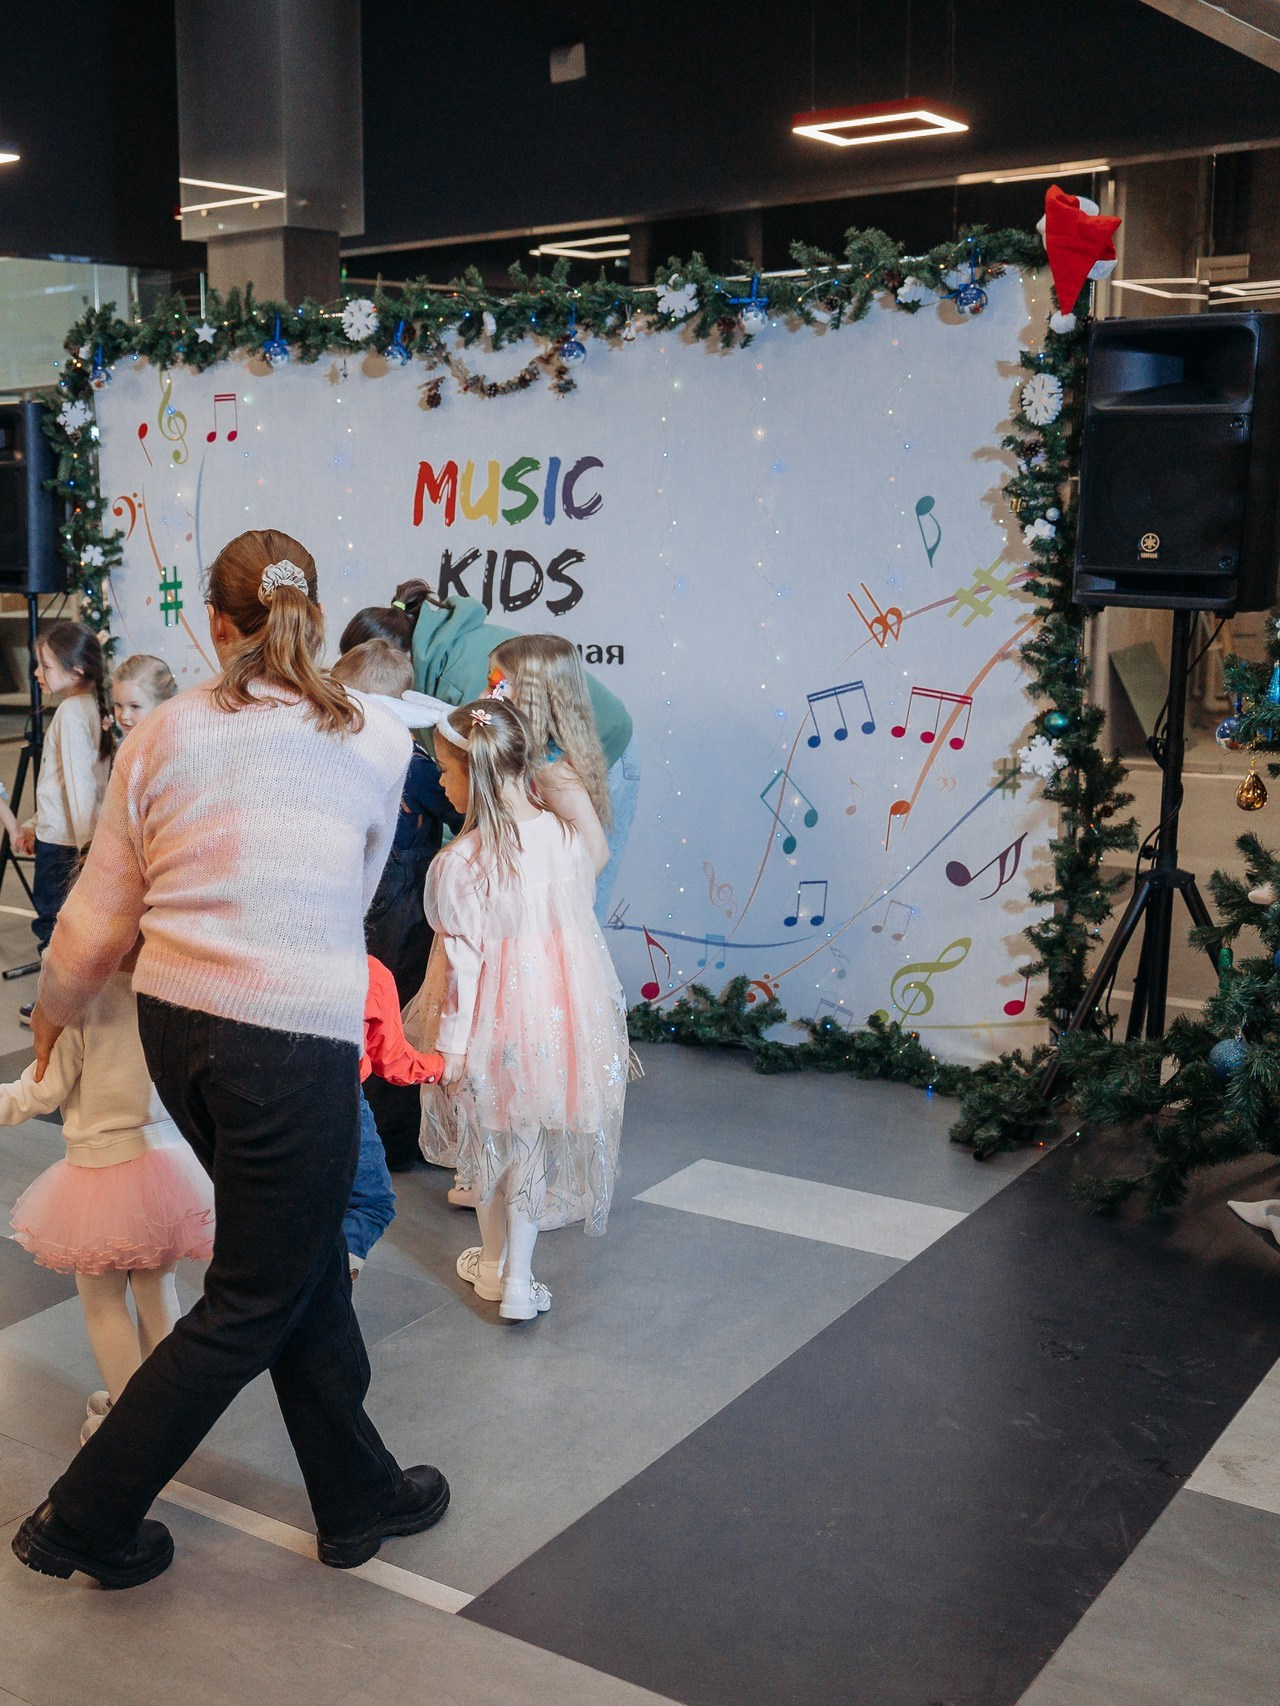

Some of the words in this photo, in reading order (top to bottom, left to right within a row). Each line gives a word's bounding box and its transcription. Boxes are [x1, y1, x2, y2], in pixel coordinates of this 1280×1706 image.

[413, 456, 604, 527] MUSIC
[438, 547, 587, 617] KIDS
[577, 644, 624, 665] ая
